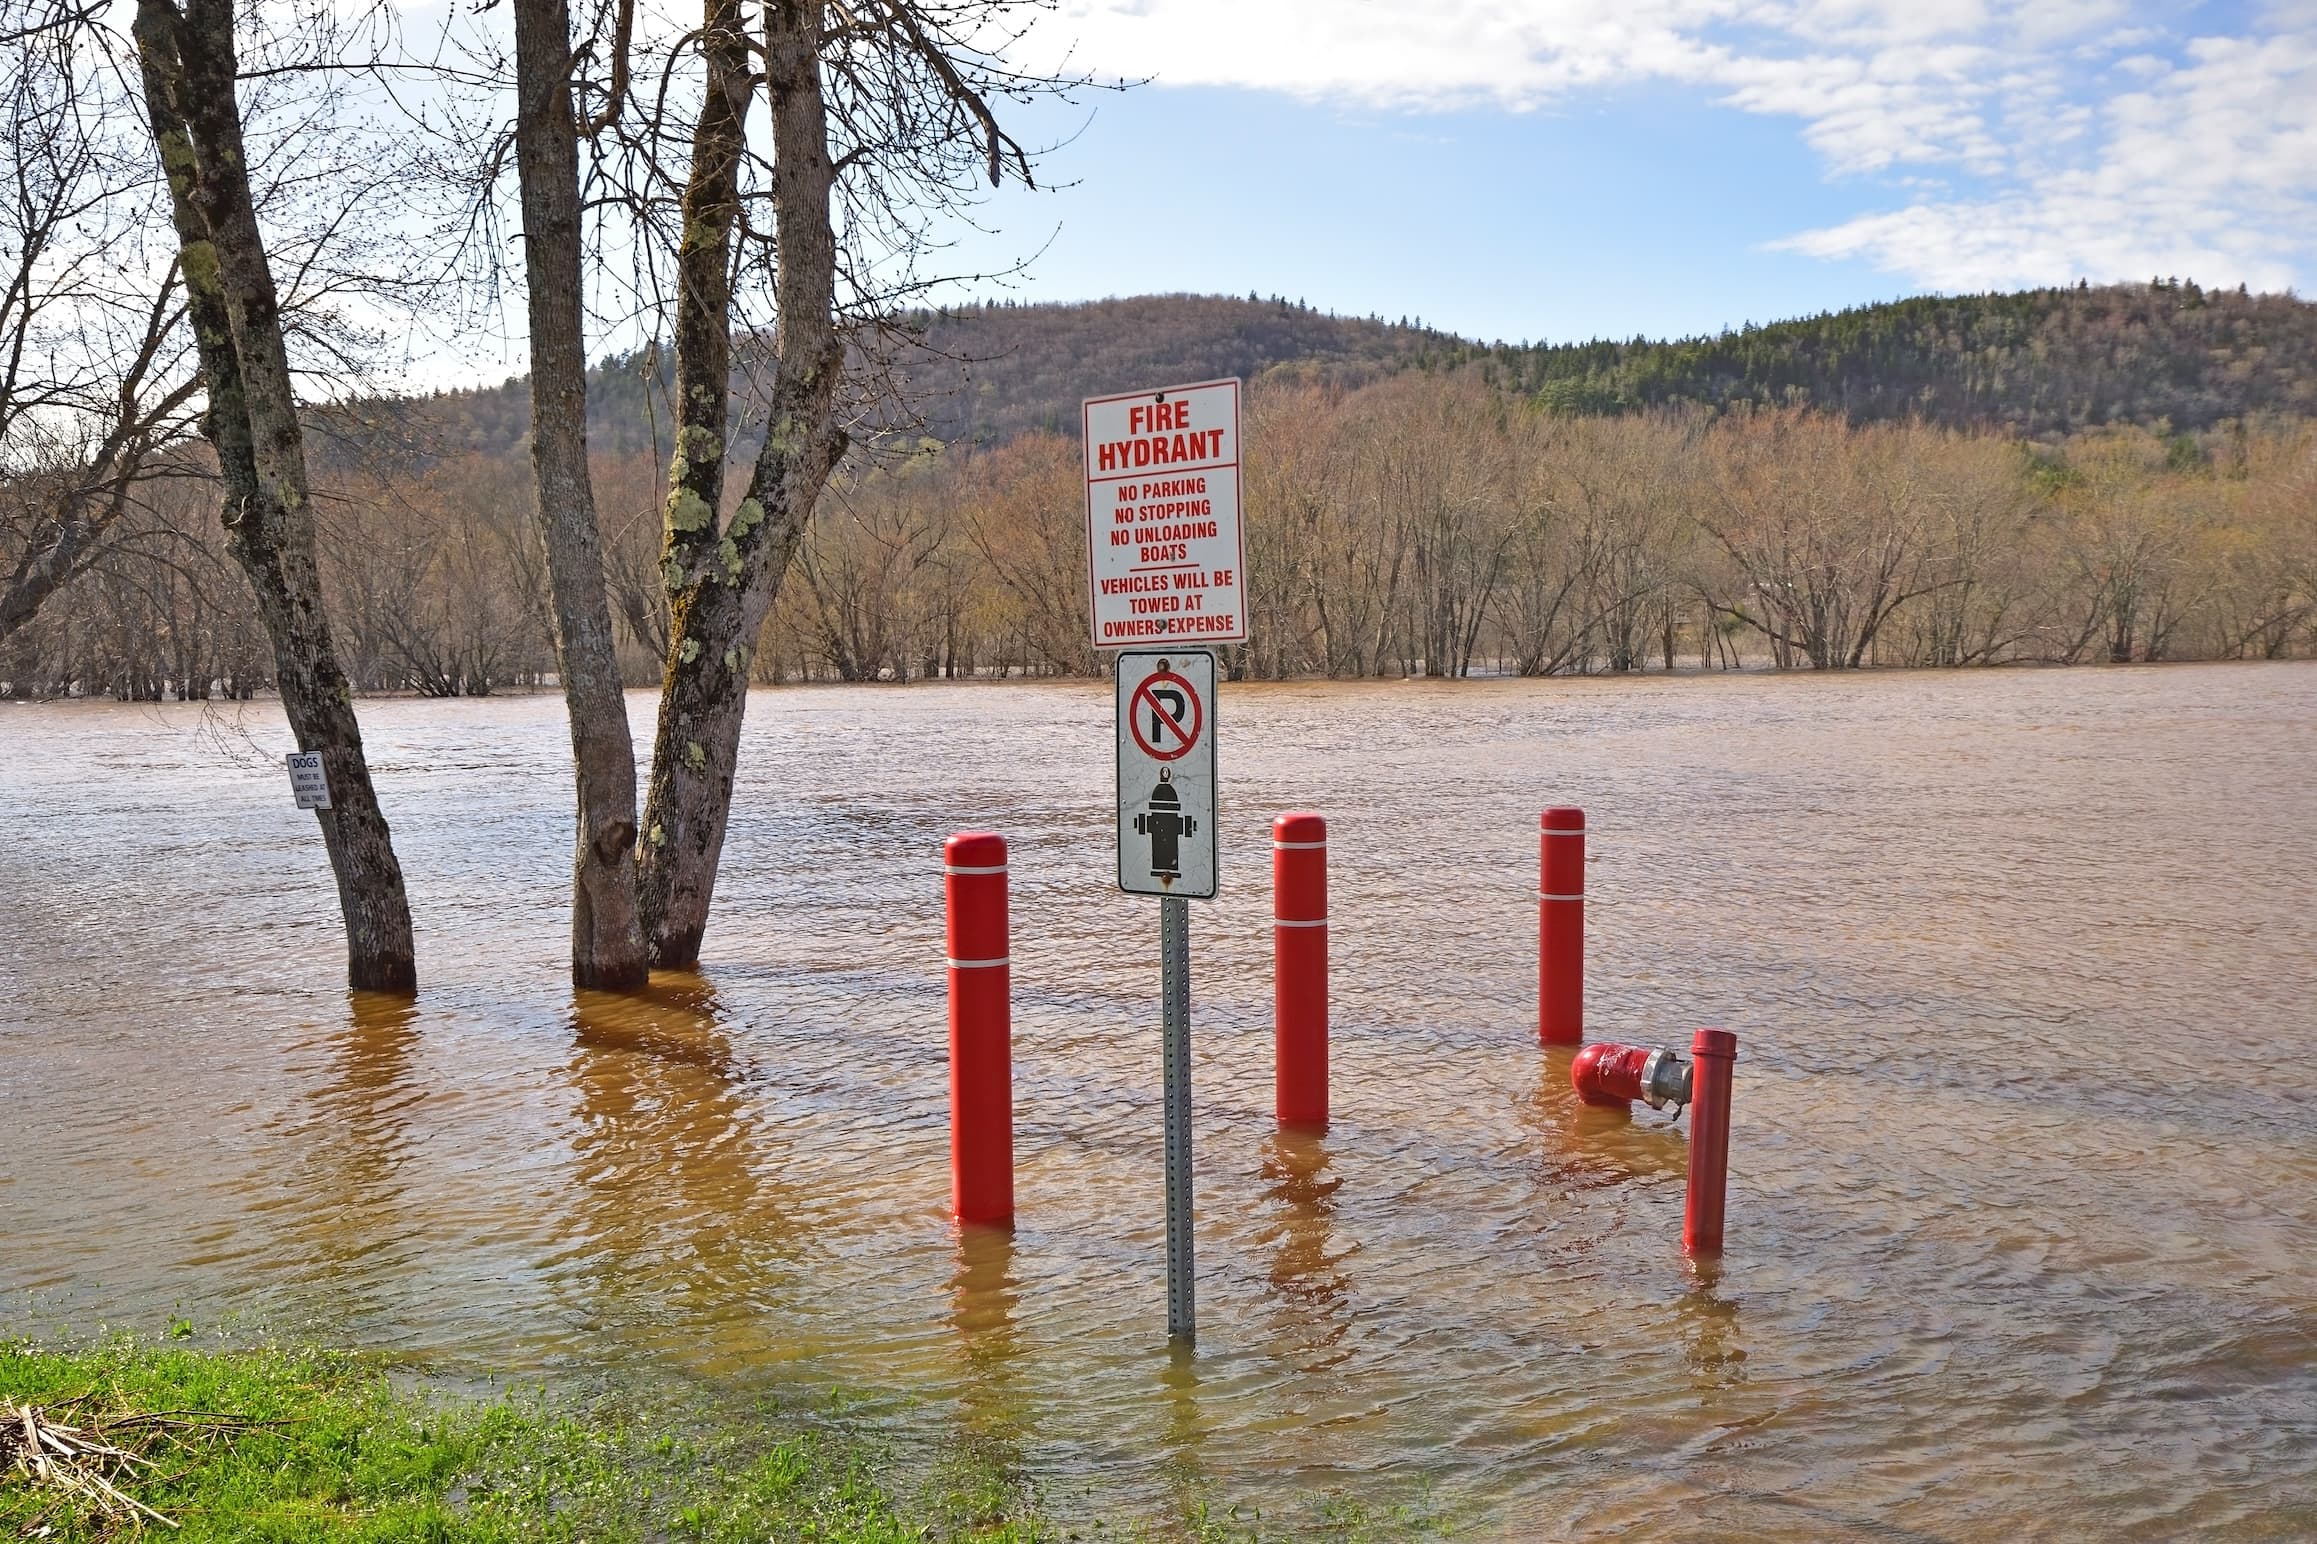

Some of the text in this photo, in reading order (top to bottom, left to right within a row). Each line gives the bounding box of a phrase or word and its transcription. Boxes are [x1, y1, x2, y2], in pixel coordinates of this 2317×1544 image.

[1129, 400, 1190, 435] FIRE
[1098, 428, 1224, 471] HYDRANT
[1118, 477, 1206, 502] NO PARKING
[1115, 499, 1211, 524] NO STOPPING
[1111, 521, 1217, 546] NO UNLOADING
[1141, 543, 1187, 562] BOATS
[1100, 570, 1233, 594] VEHICLES WILL BE
[1129, 594, 1203, 614] TOWED AT
[1168, 615, 1234, 634] EXPENSE
[292, 757, 318, 768] DOGS
[296, 784, 318, 792] LEASHED
[297, 773, 311, 781] MUST
